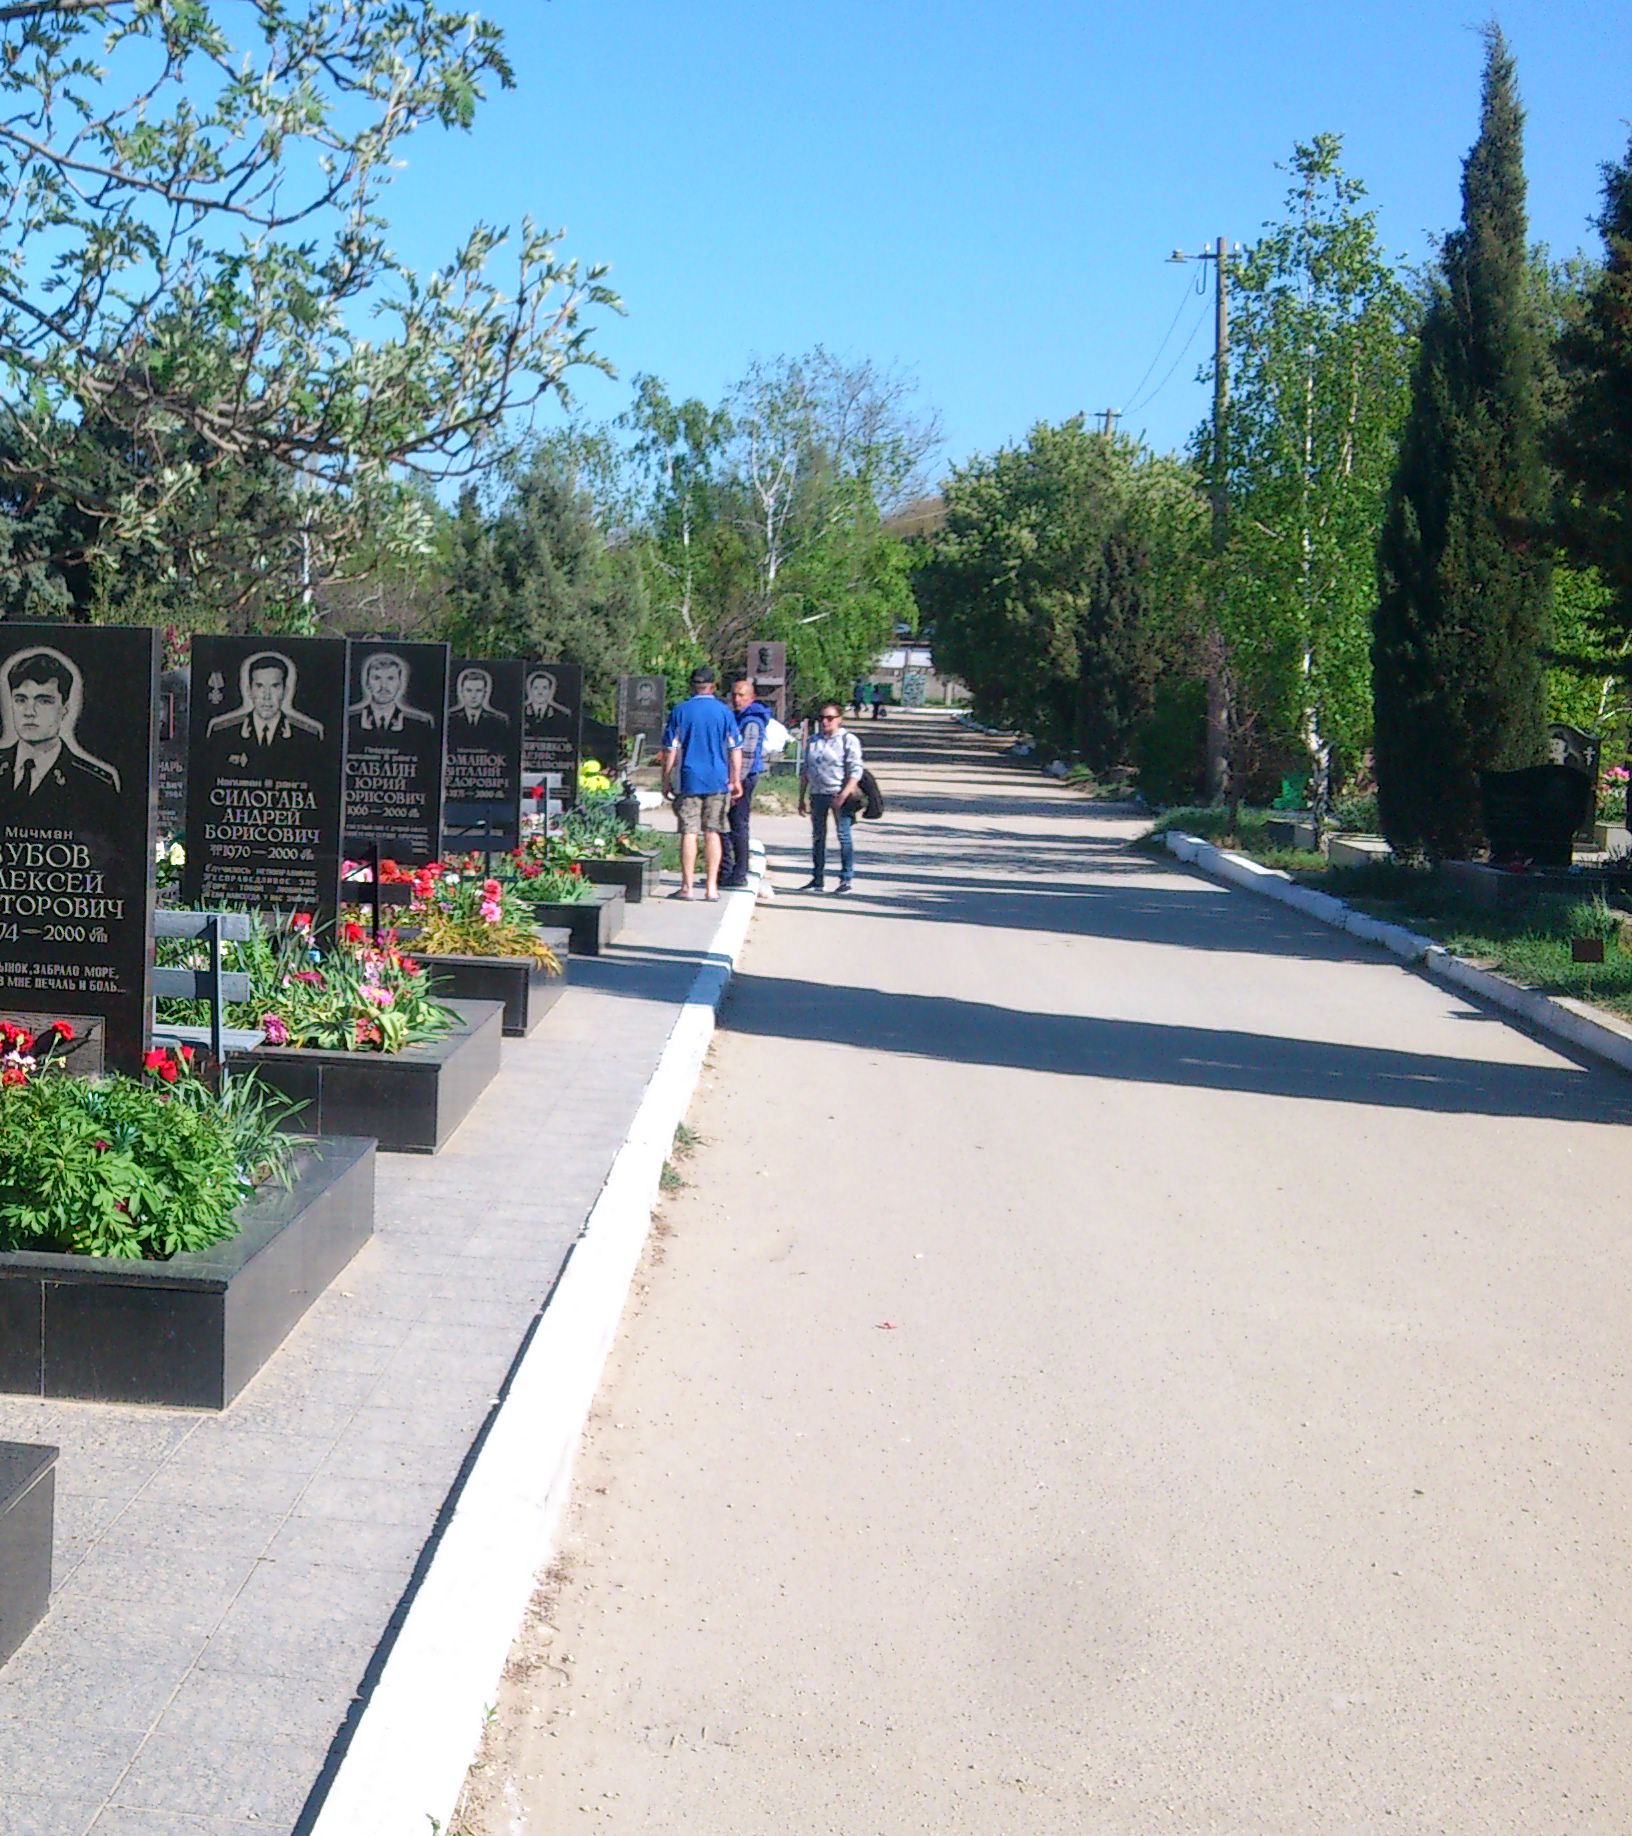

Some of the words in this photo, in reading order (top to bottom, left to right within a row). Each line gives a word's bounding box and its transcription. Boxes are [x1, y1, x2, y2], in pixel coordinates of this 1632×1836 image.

[447, 754, 507, 766] ОМАНЮК
[346, 761, 417, 777] САБЛИН
[354, 776, 406, 790] ЮРИЙ
[445, 777, 509, 788] ЕДОРОВИЧ
[210, 788, 318, 809] СИЛОГАВА
[345, 790, 426, 805] ОРИСОВИЧ
[222, 807, 301, 826] АНДРЕЙ
[383, 807, 407, 817] 2000
[5, 826, 73, 840] Мичман
[205, 824, 320, 843] БОРИСОВИЧ
[223, 845, 251, 859] 1970
[268, 847, 298, 859] 2000
[43, 925, 85, 942] 2000
[33, 963, 79, 977] ЗАБРАЛО
[84, 966, 120, 980] МОРЕ,
[7, 977, 31, 989] МНЕ
[35, 978, 76, 991] ПЕЧАЛЬ
[79, 980, 86, 990] И
